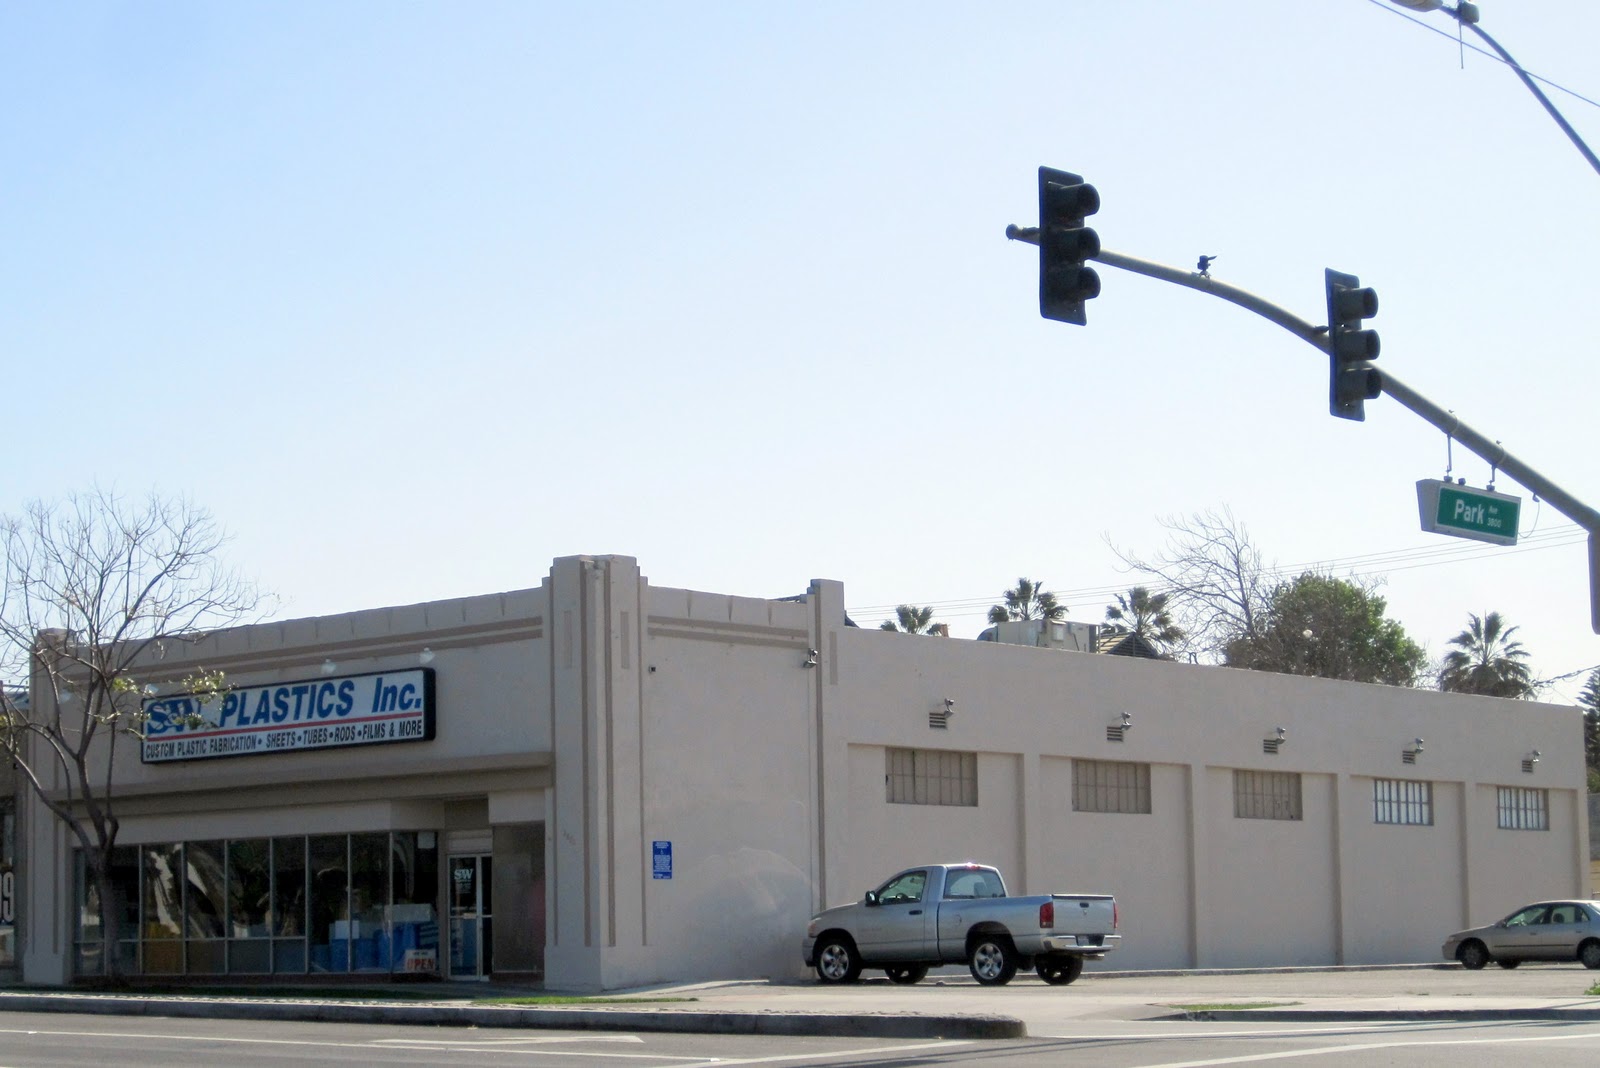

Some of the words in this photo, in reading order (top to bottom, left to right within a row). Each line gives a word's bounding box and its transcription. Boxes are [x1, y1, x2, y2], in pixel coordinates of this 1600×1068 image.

[1454, 499, 1485, 525] Park
[219, 680, 355, 728] PLASTICS
[371, 677, 422, 714] Inc.
[145, 742, 175, 759] CUSTOM
[177, 739, 207, 756] PLASTIC
[209, 735, 257, 753] FABRICATION
[266, 731, 296, 748] SHEETS
[303, 728, 331, 745] TUBES
[334, 725, 356, 742] RODS
[362, 722, 385, 740] FILMS
[389, 722, 395, 737] &
[398, 719, 422, 737] MORE
[407, 958, 434, 970] OPEN
